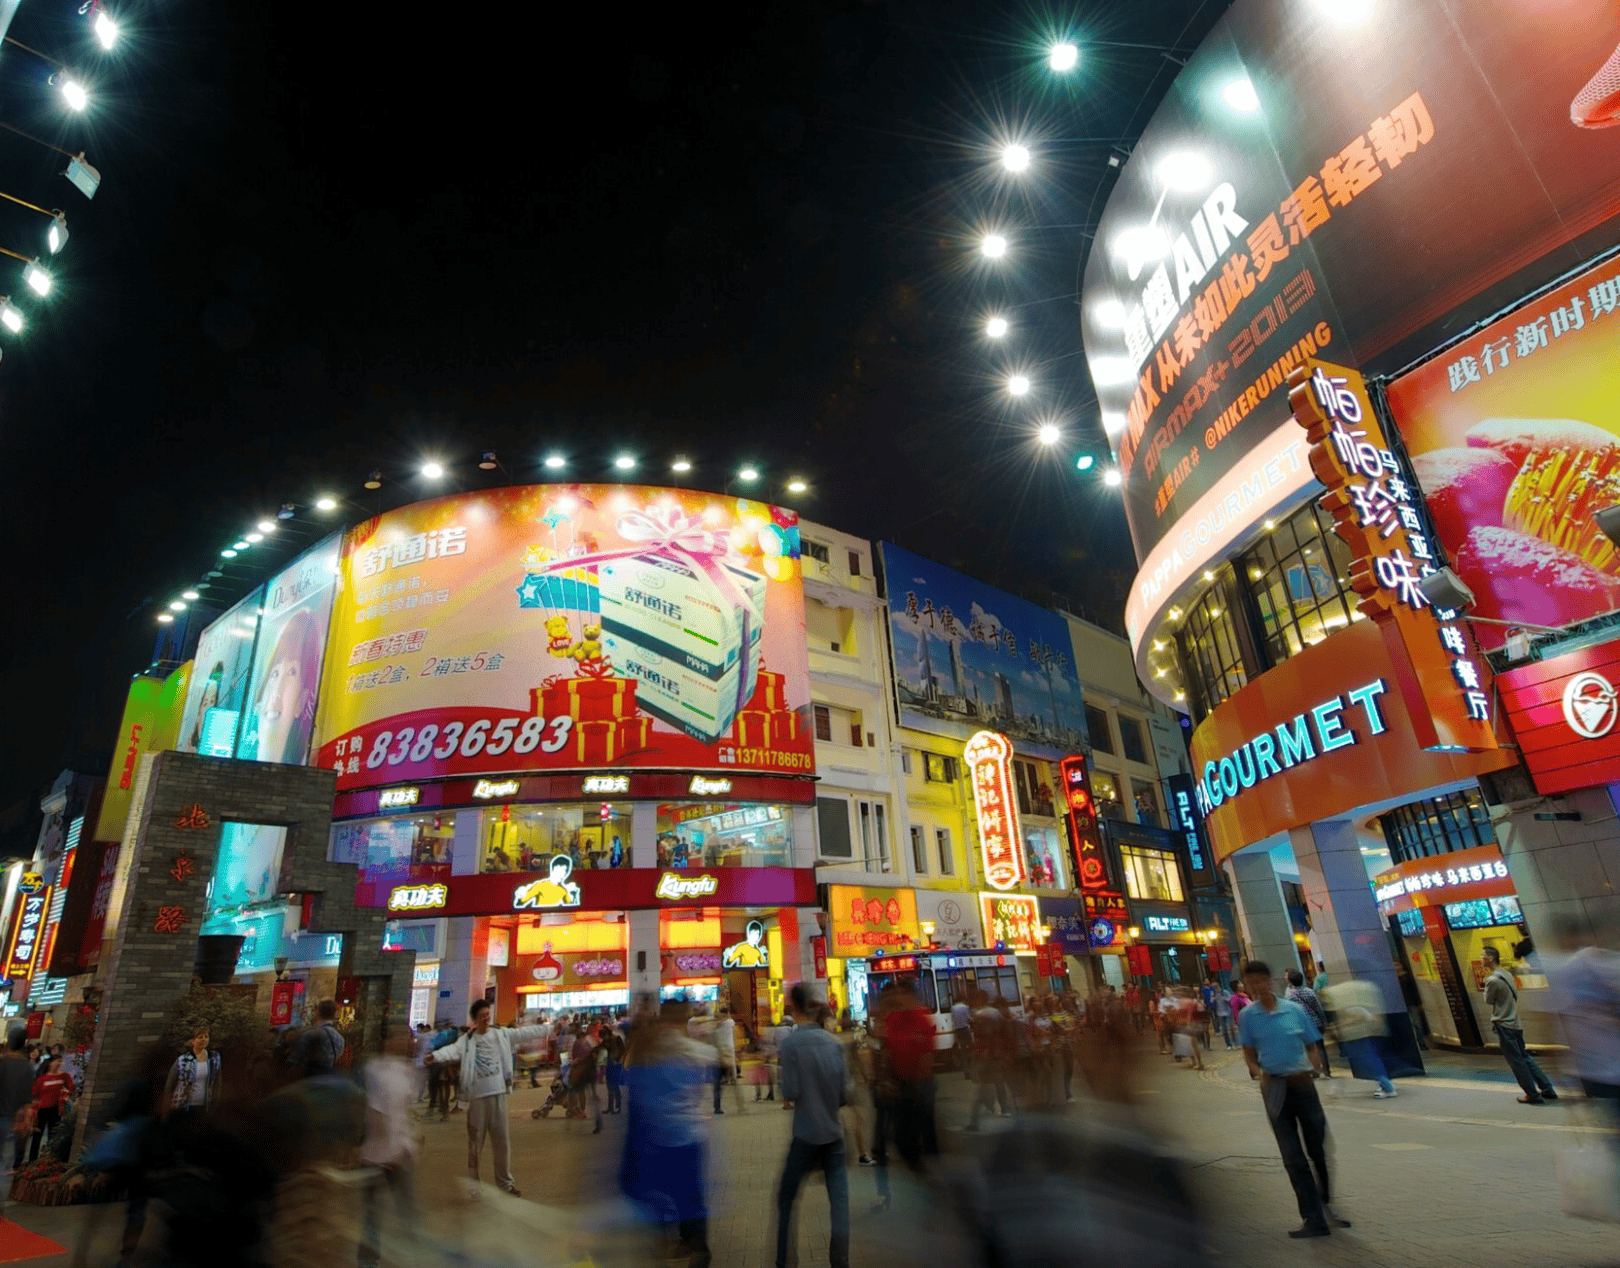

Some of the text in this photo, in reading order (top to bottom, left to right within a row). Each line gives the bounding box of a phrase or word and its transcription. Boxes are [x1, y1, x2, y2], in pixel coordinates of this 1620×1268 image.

[1155, 91, 1435, 394] 从未如此灵活轻韧
[1447, 274, 1620, 393] 践行新时期
[1204, 321, 1332, 450] @NIKERUNNING
[362, 526, 468, 579] 舒通诺
[624, 586, 682, 620] 舒通诺
[420, 651, 505, 678] 2箱送5盒
[626, 659, 680, 695] 舒通诺
[334, 735, 363, 757] 订购
[366, 715, 573, 769] 83836583
[736, 747, 811, 768] 13711786678
[379, 788, 418, 807] 真功夫
[473, 779, 519, 798] Kungfu
[583, 776, 629, 792] 真功夫
[689, 776, 732, 794] Kungfu
[154, 803, 210, 933] 北京路
[391, 886, 445, 909] 真功夫
[658, 874, 716, 898] Kungfu
